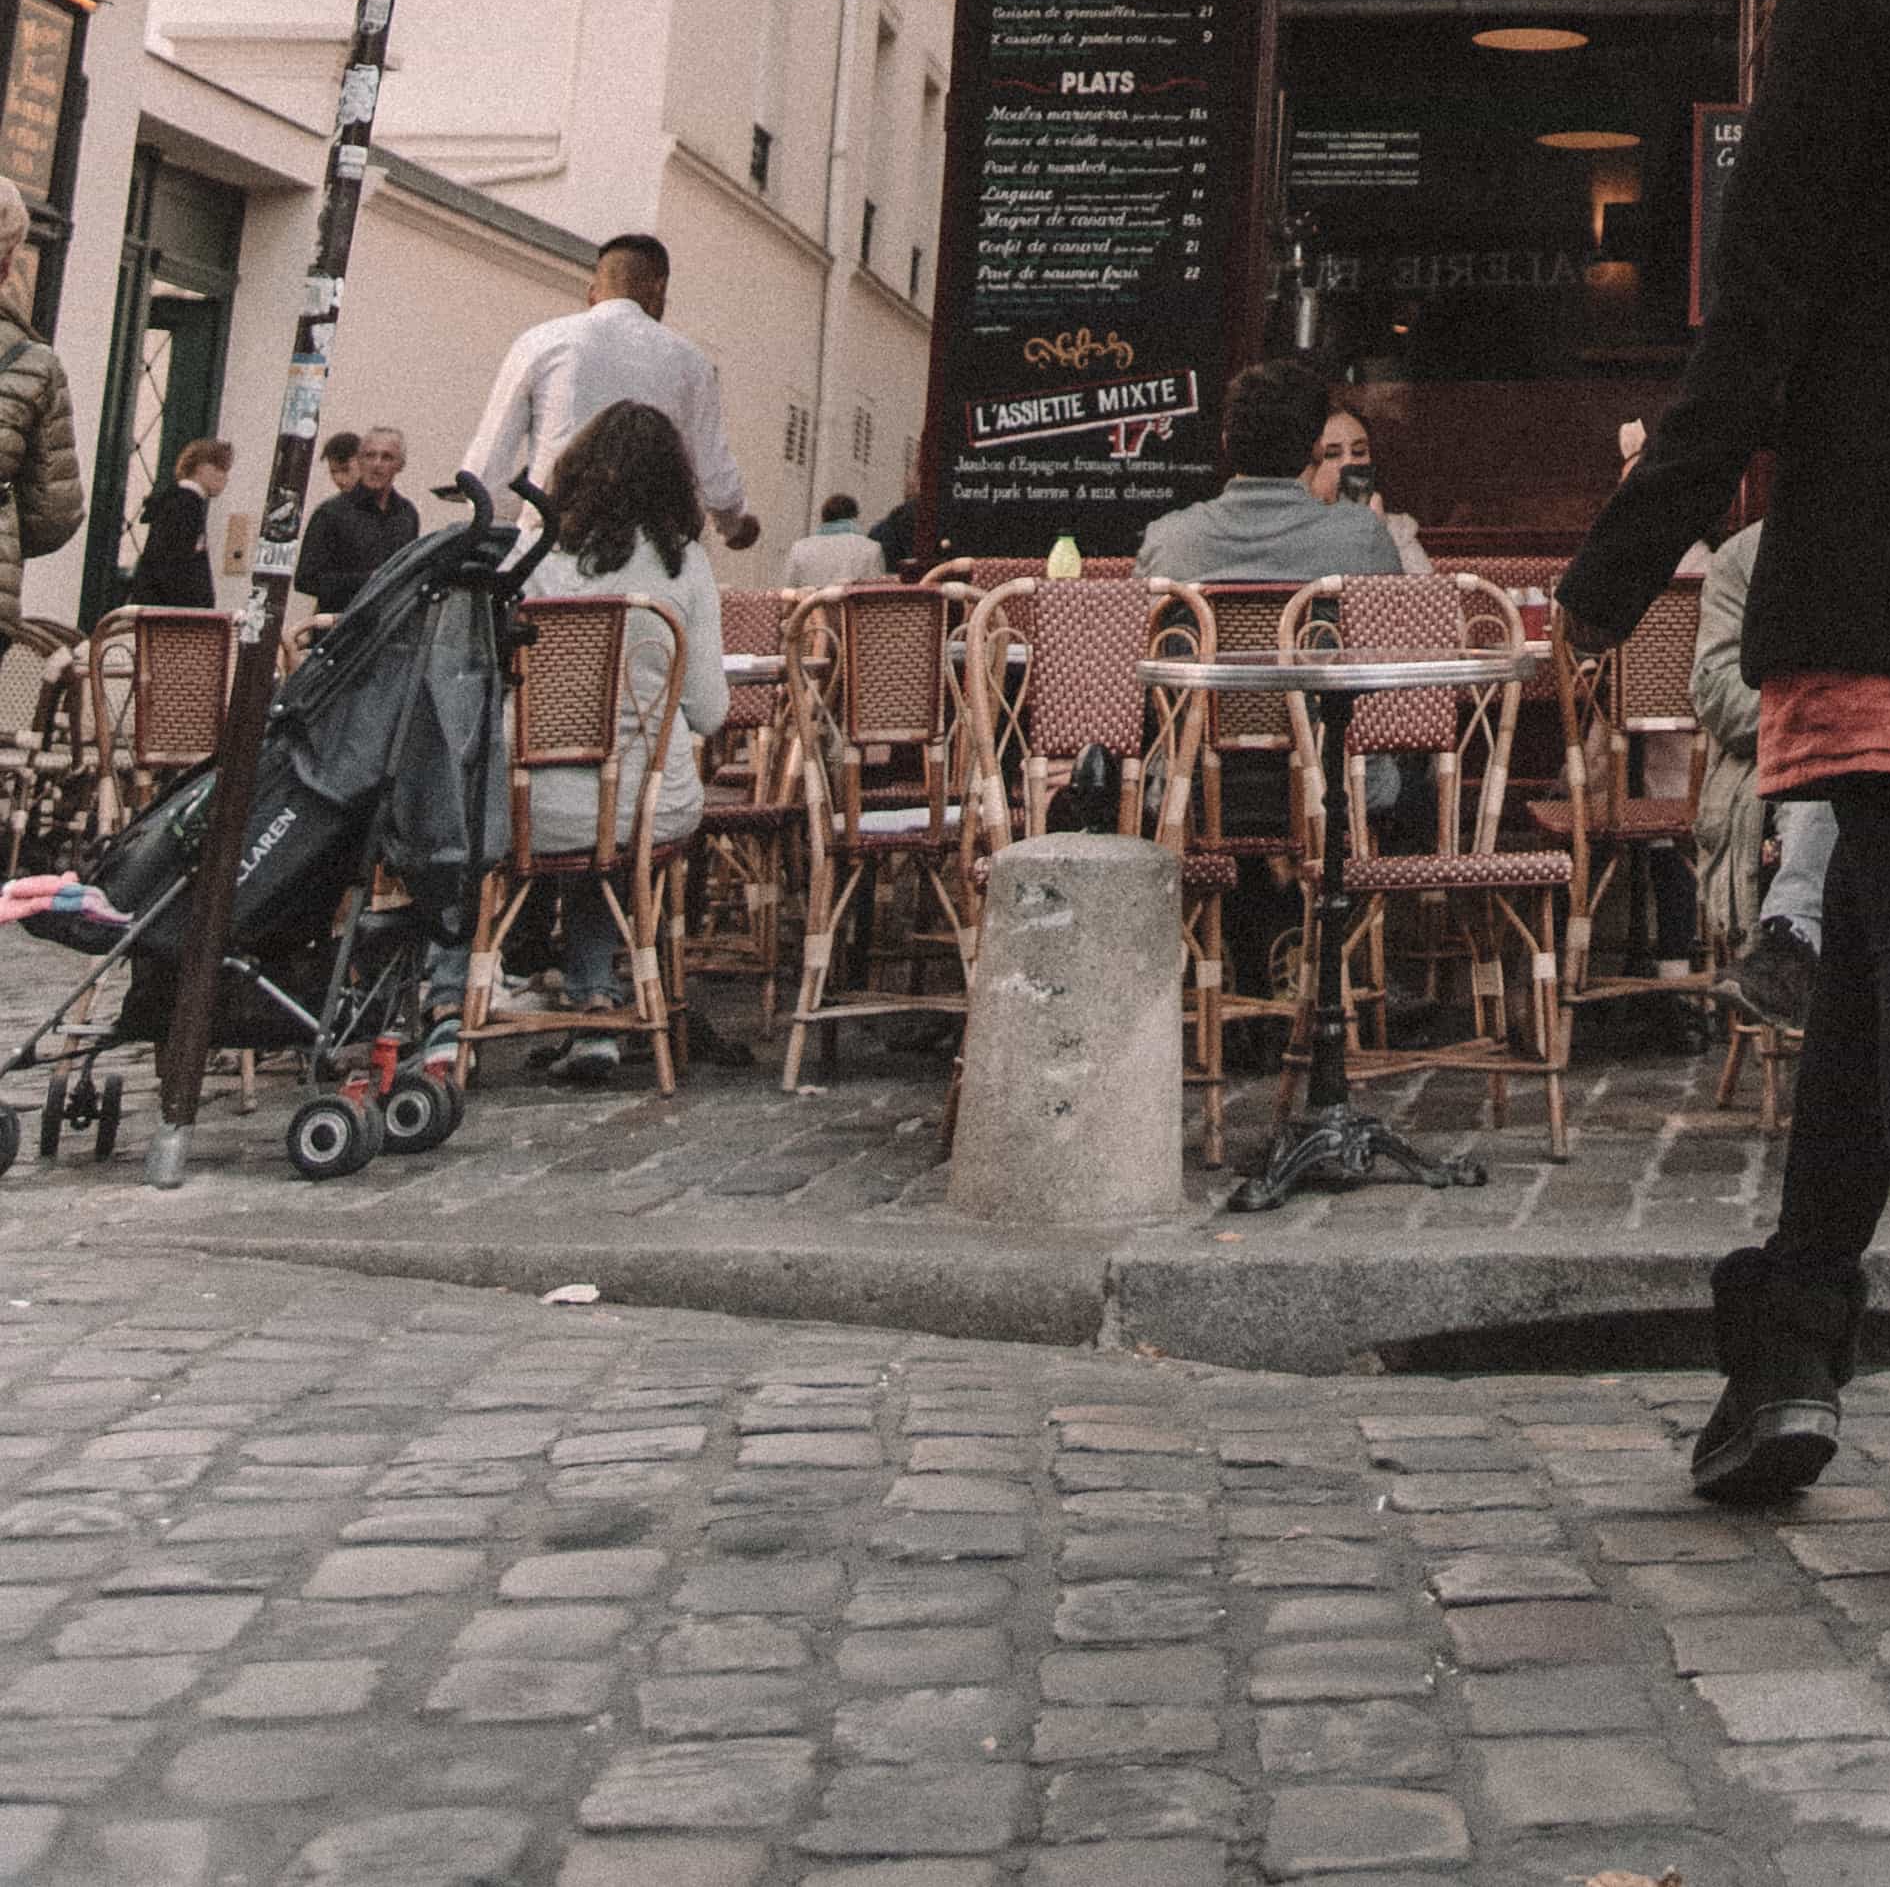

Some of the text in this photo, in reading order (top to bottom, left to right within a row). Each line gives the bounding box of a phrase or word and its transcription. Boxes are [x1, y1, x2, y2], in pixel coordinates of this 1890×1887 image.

[1045, 6, 1061, 19] de
[1061, 71, 1136, 95] PLATS
[985, 106, 1043, 122] Moules
[1715, 124, 1742, 142] LES
[1021, 160, 1041, 175] de
[980, 186, 1054, 206] Linguine
[979, 211, 1041, 231] Magret
[1046, 211, 1067, 227] de
[1071, 211, 1126, 227] canard
[1027, 239, 1048, 254] de
[1052, 237, 1113, 254] canard
[1018, 265, 1038, 280] de
[976, 377, 1178, 434] L'ASSIETTE MIXTE
[953, 482, 990, 499] Cured
[992, 482, 1022, 504] pork
